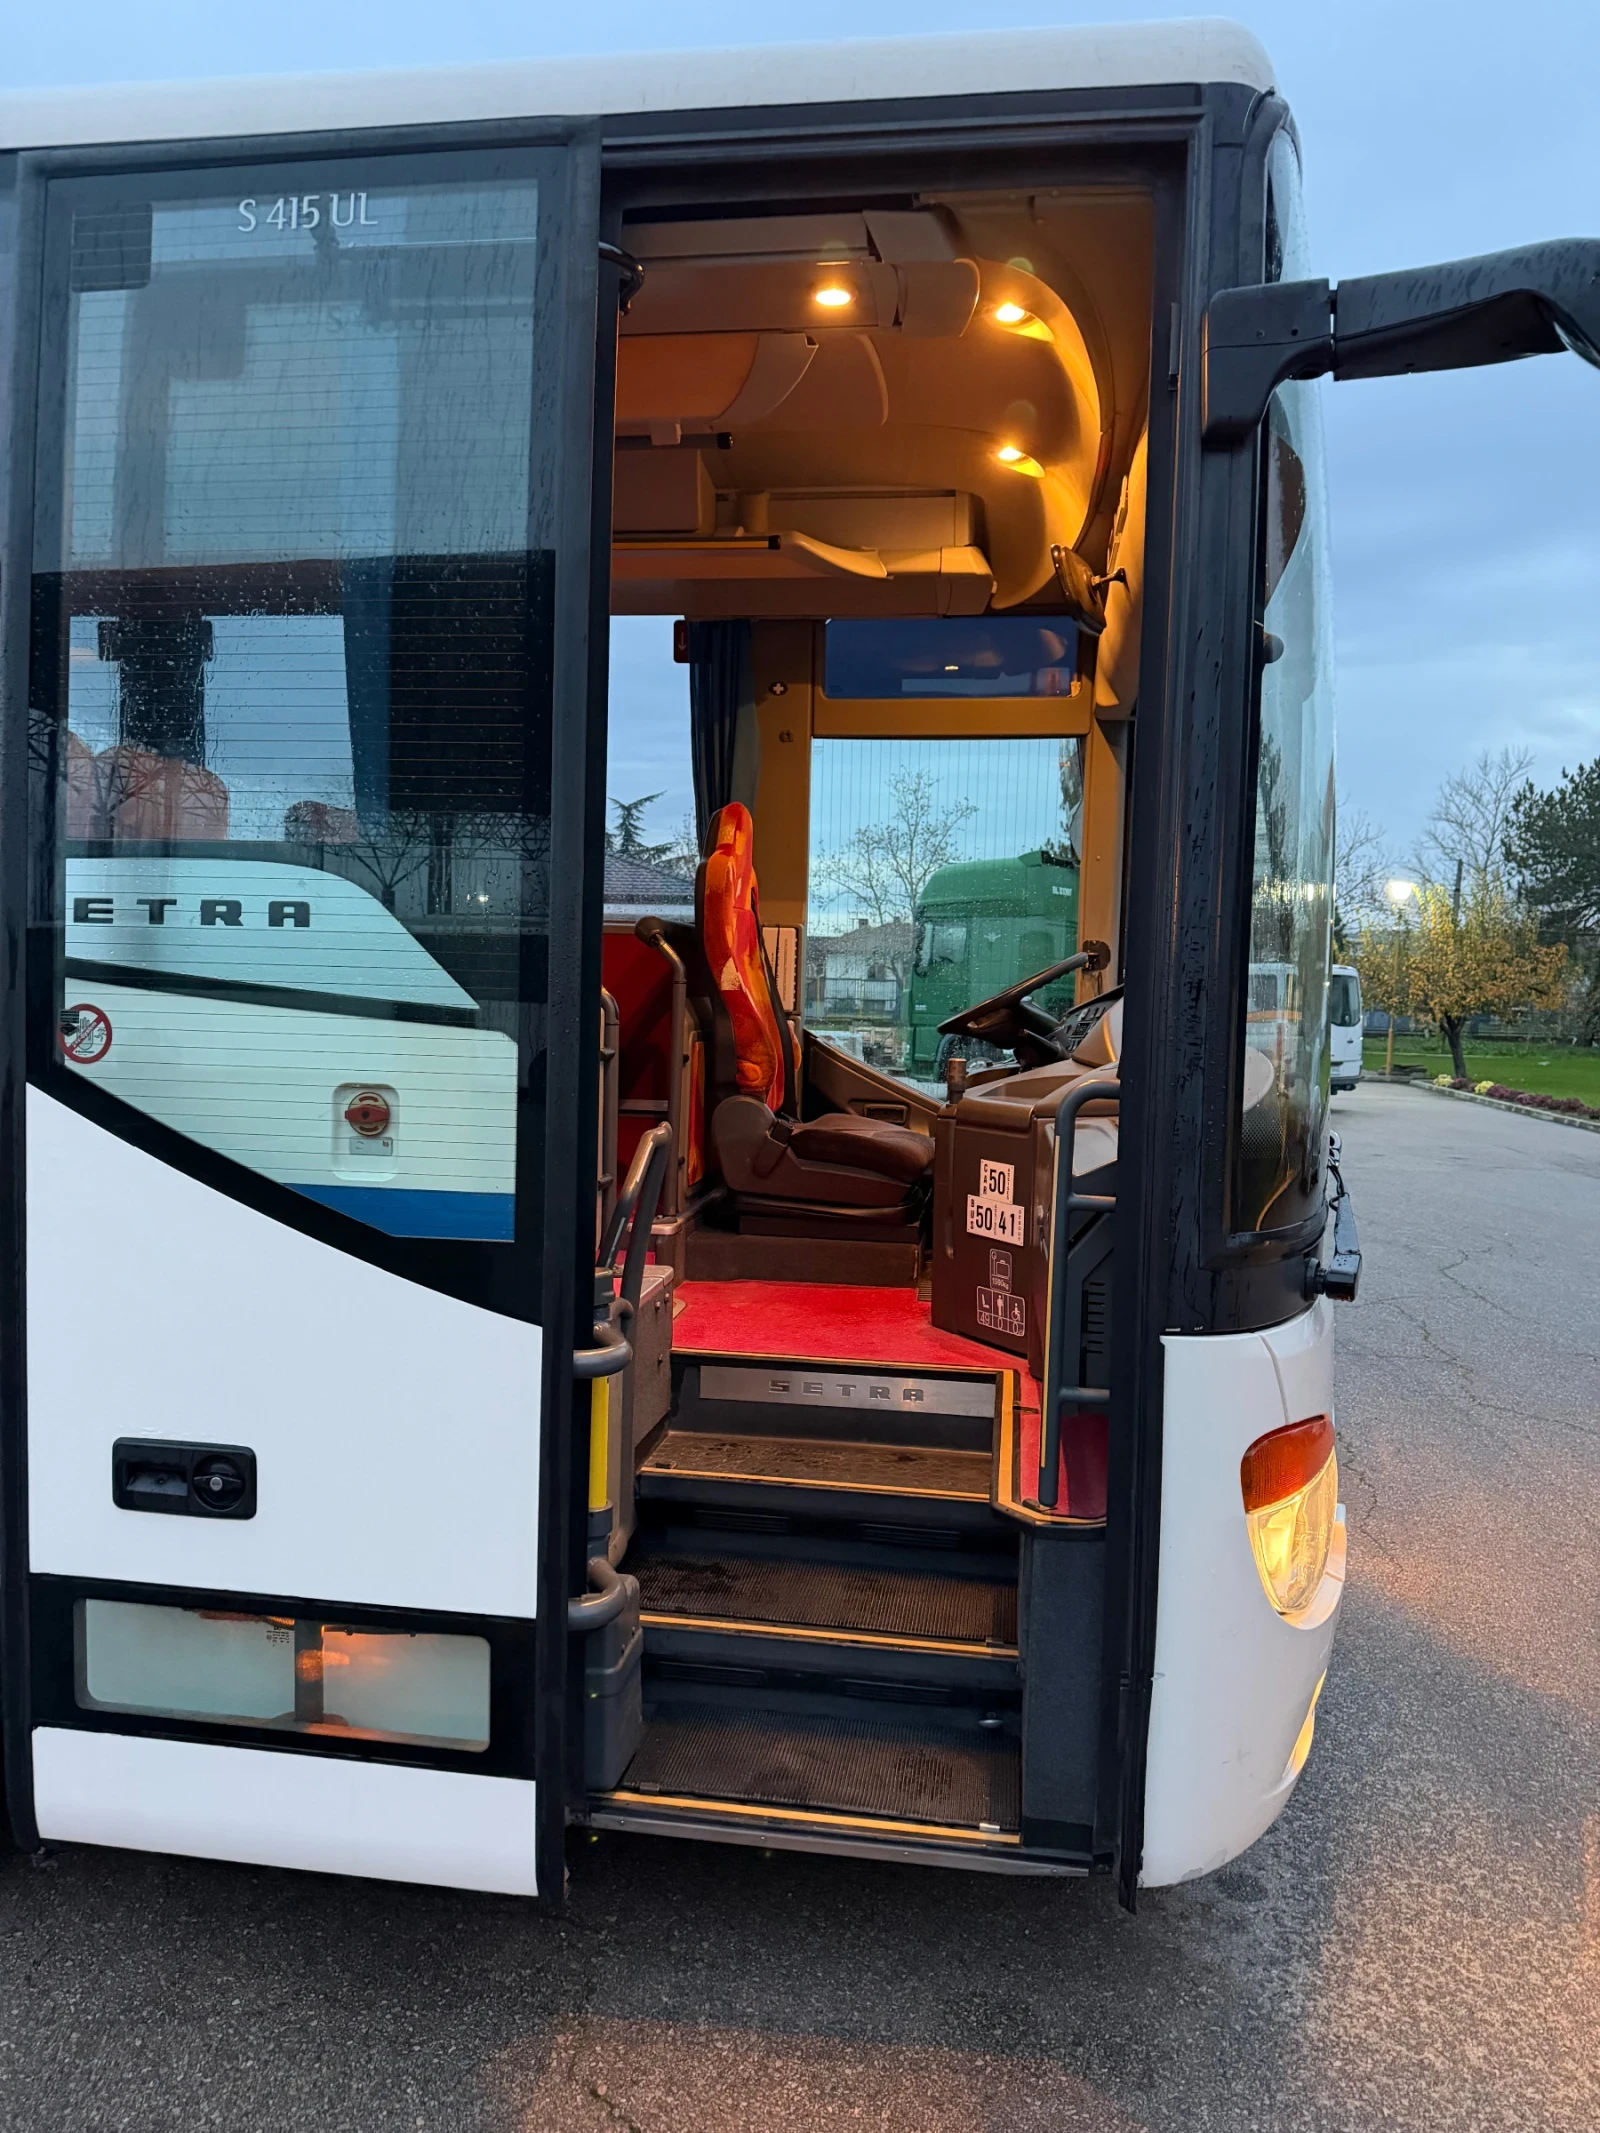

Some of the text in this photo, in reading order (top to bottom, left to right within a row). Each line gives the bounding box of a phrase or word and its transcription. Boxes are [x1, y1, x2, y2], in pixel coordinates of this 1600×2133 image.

[238, 192, 378, 232] S 415 UL
[73, 897, 310, 928] ETRA
[989, 1168, 1006, 1195] 50
[975, 1205, 993, 1231] 50
[998, 1211, 1015, 1237] 41
[980, 1312, 990, 1325] 49
[997, 1316, 1003, 1330] 0
[1012, 1320, 1019, 1334] 0
[768, 1379, 925, 1402] SETRA
